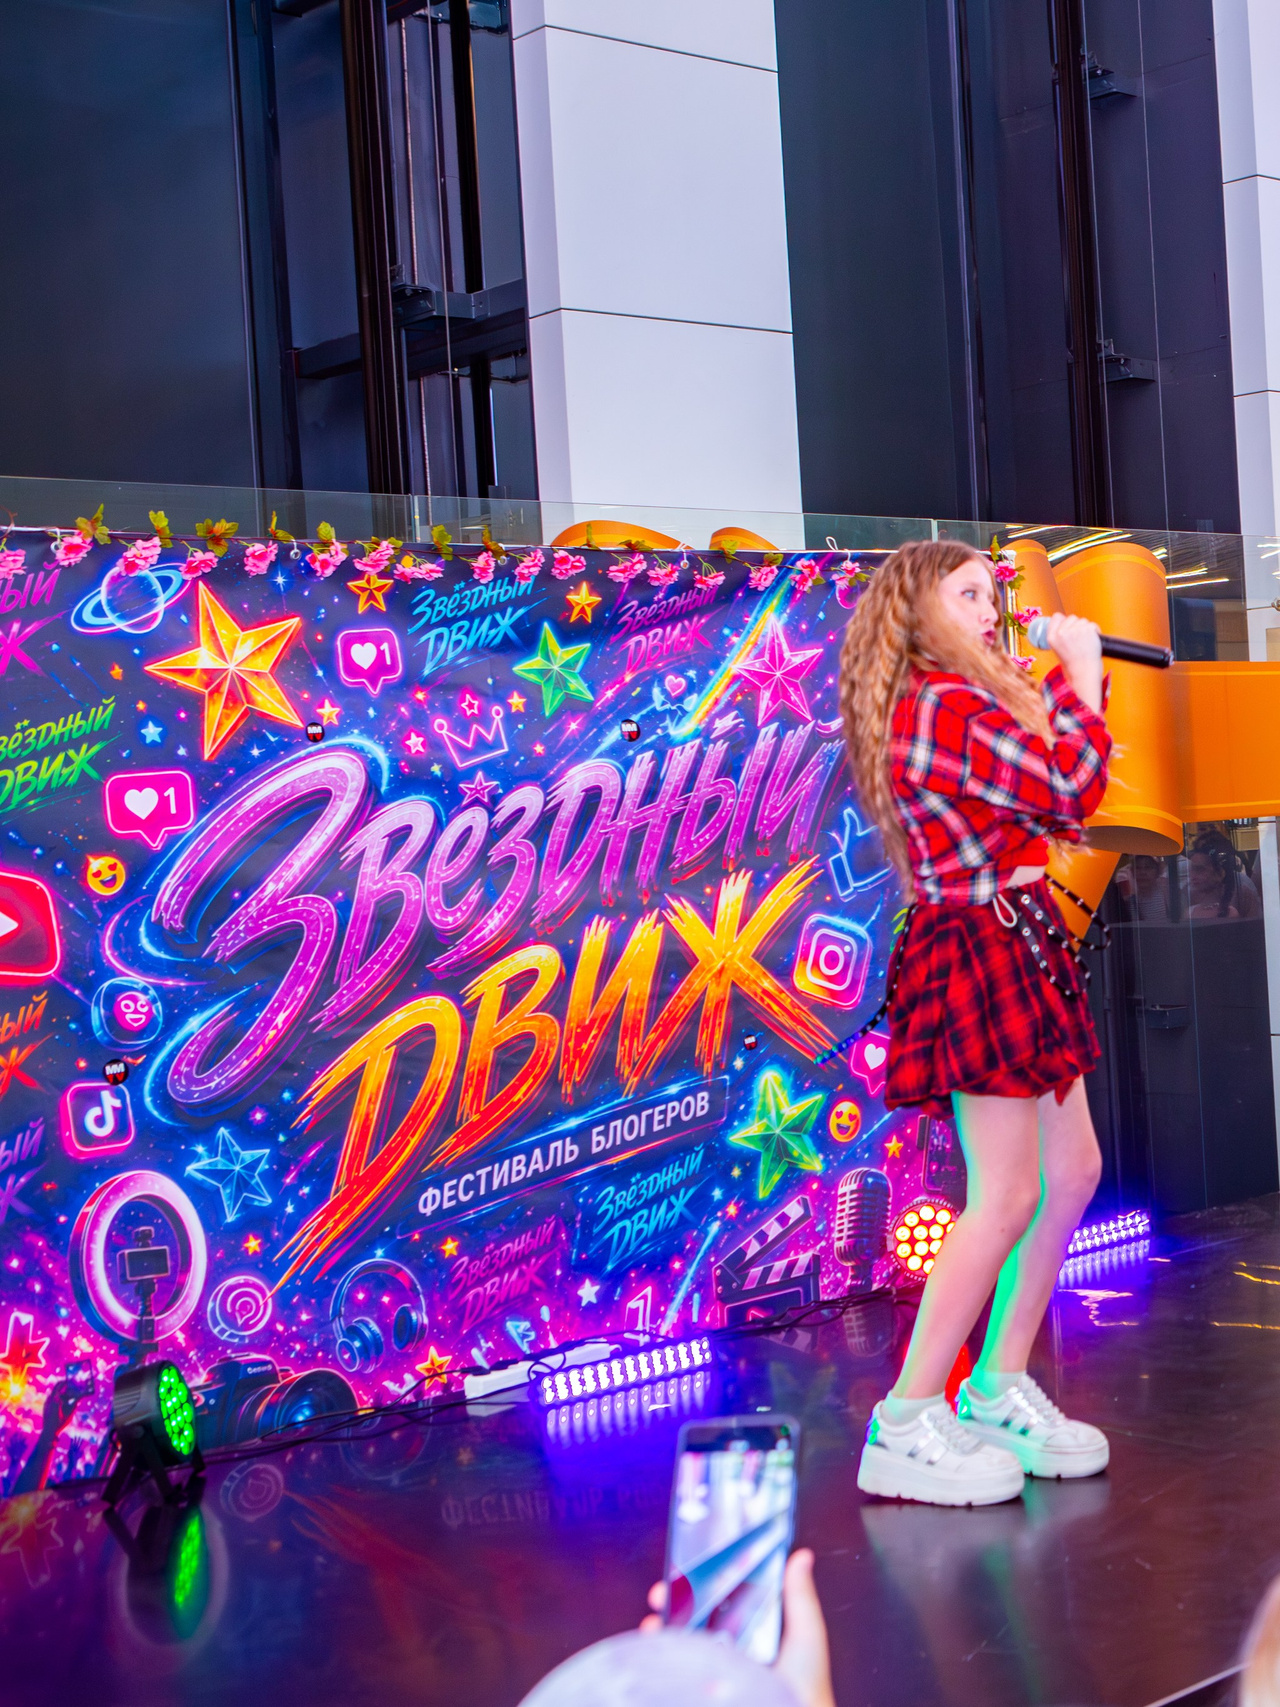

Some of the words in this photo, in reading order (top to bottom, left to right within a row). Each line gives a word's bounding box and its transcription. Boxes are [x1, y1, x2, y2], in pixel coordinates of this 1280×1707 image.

[420, 605, 533, 677] ДВИЖ
[621, 613, 714, 673] ДВИЖ
[265, 856, 842, 1300] ДВИЖ
[418, 1137, 580, 1216] ФЕСТИВАЛЬ
[591, 1091, 710, 1154] БЛОГЕРОВ
[604, 1188, 698, 1270] ДВИЖ
[462, 1254, 551, 1330] ДВИЖ
